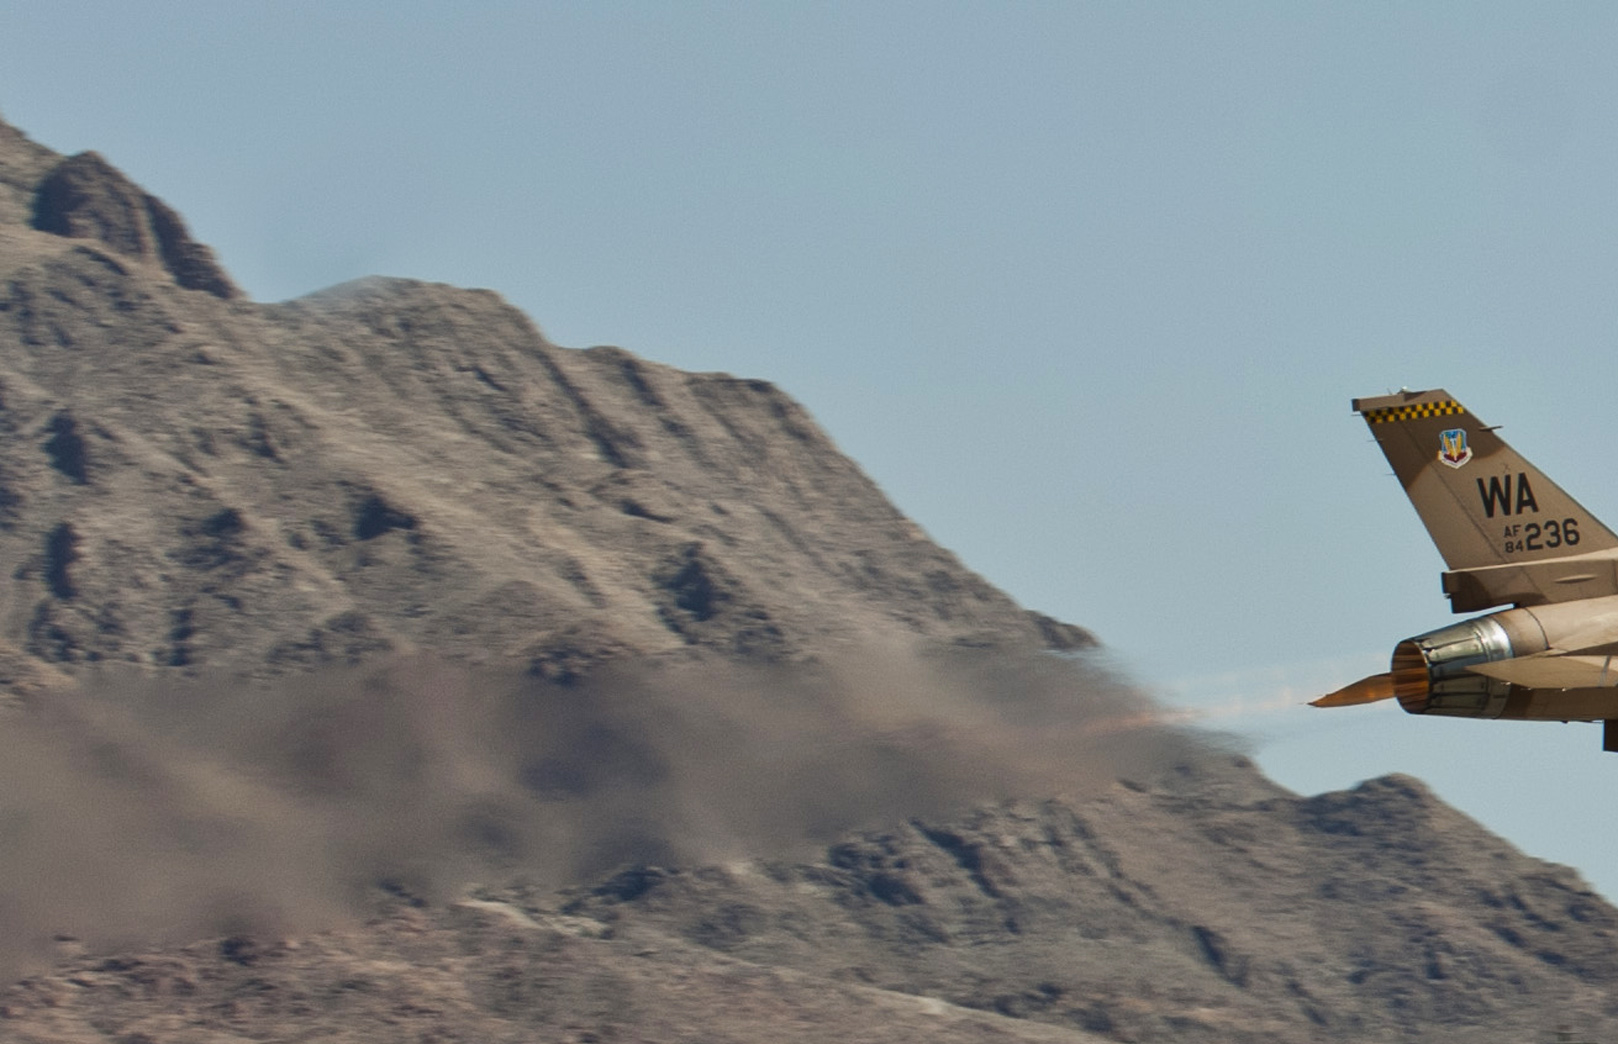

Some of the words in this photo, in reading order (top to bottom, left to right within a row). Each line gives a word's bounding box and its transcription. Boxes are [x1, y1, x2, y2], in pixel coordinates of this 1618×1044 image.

[1477, 473, 1538, 518] WA
[1504, 525, 1521, 538] AF
[1525, 518, 1580, 551] 236
[1505, 541, 1523, 553] 84
